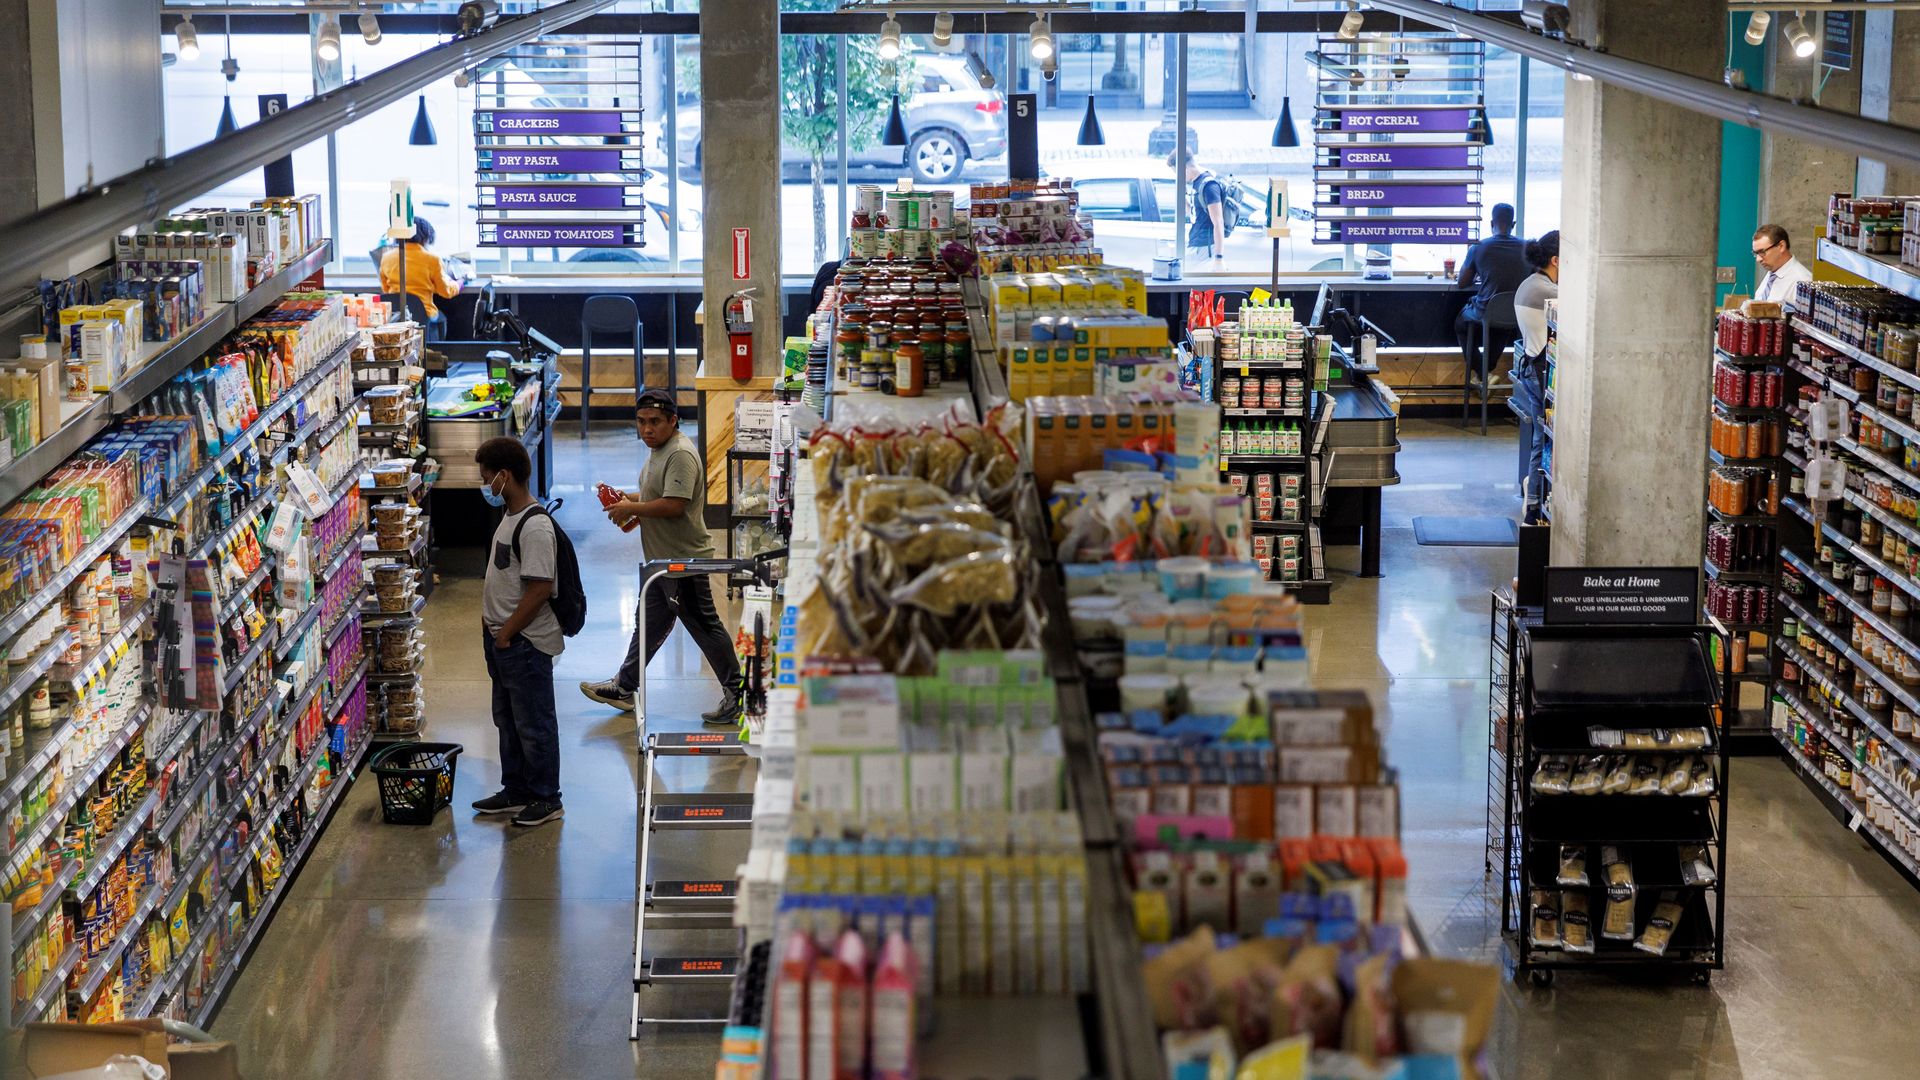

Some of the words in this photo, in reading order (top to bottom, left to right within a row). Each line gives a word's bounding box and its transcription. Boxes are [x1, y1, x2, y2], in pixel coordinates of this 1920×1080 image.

[267, 99, 280, 116] 6
[1016, 100, 1028, 117] 5
[499, 119, 559, 128] CRACKERS
[1348, 116, 1373, 125] HOT
[1375, 116, 1419, 125] CEREAL
[499, 156, 522, 166] DRY
[524, 156, 559, 166] PASTA
[1347, 153, 1391, 162] CEREAL
[501, 193, 536, 203] PASTA
[539, 193, 576, 203] SAUCE
[1347, 190, 1384, 199] BREAD
[503, 230, 551, 240] CANNED
[554, 230, 614, 240] TOMATOES
[1347, 227, 1387, 236] PEANUT
[1389, 227, 1424, 236] BUTTER
[1427, 227, 1434, 236] &
[1436, 227, 1462, 236] JELLY
[1775, 324, 1783, 352] CLEAN
[1735, 375, 1743, 401] CLEAN
[1583, 576, 1612, 587] Bake
[1614, 577, 1625, 587] at
[1627, 576, 1660, 587] Home
